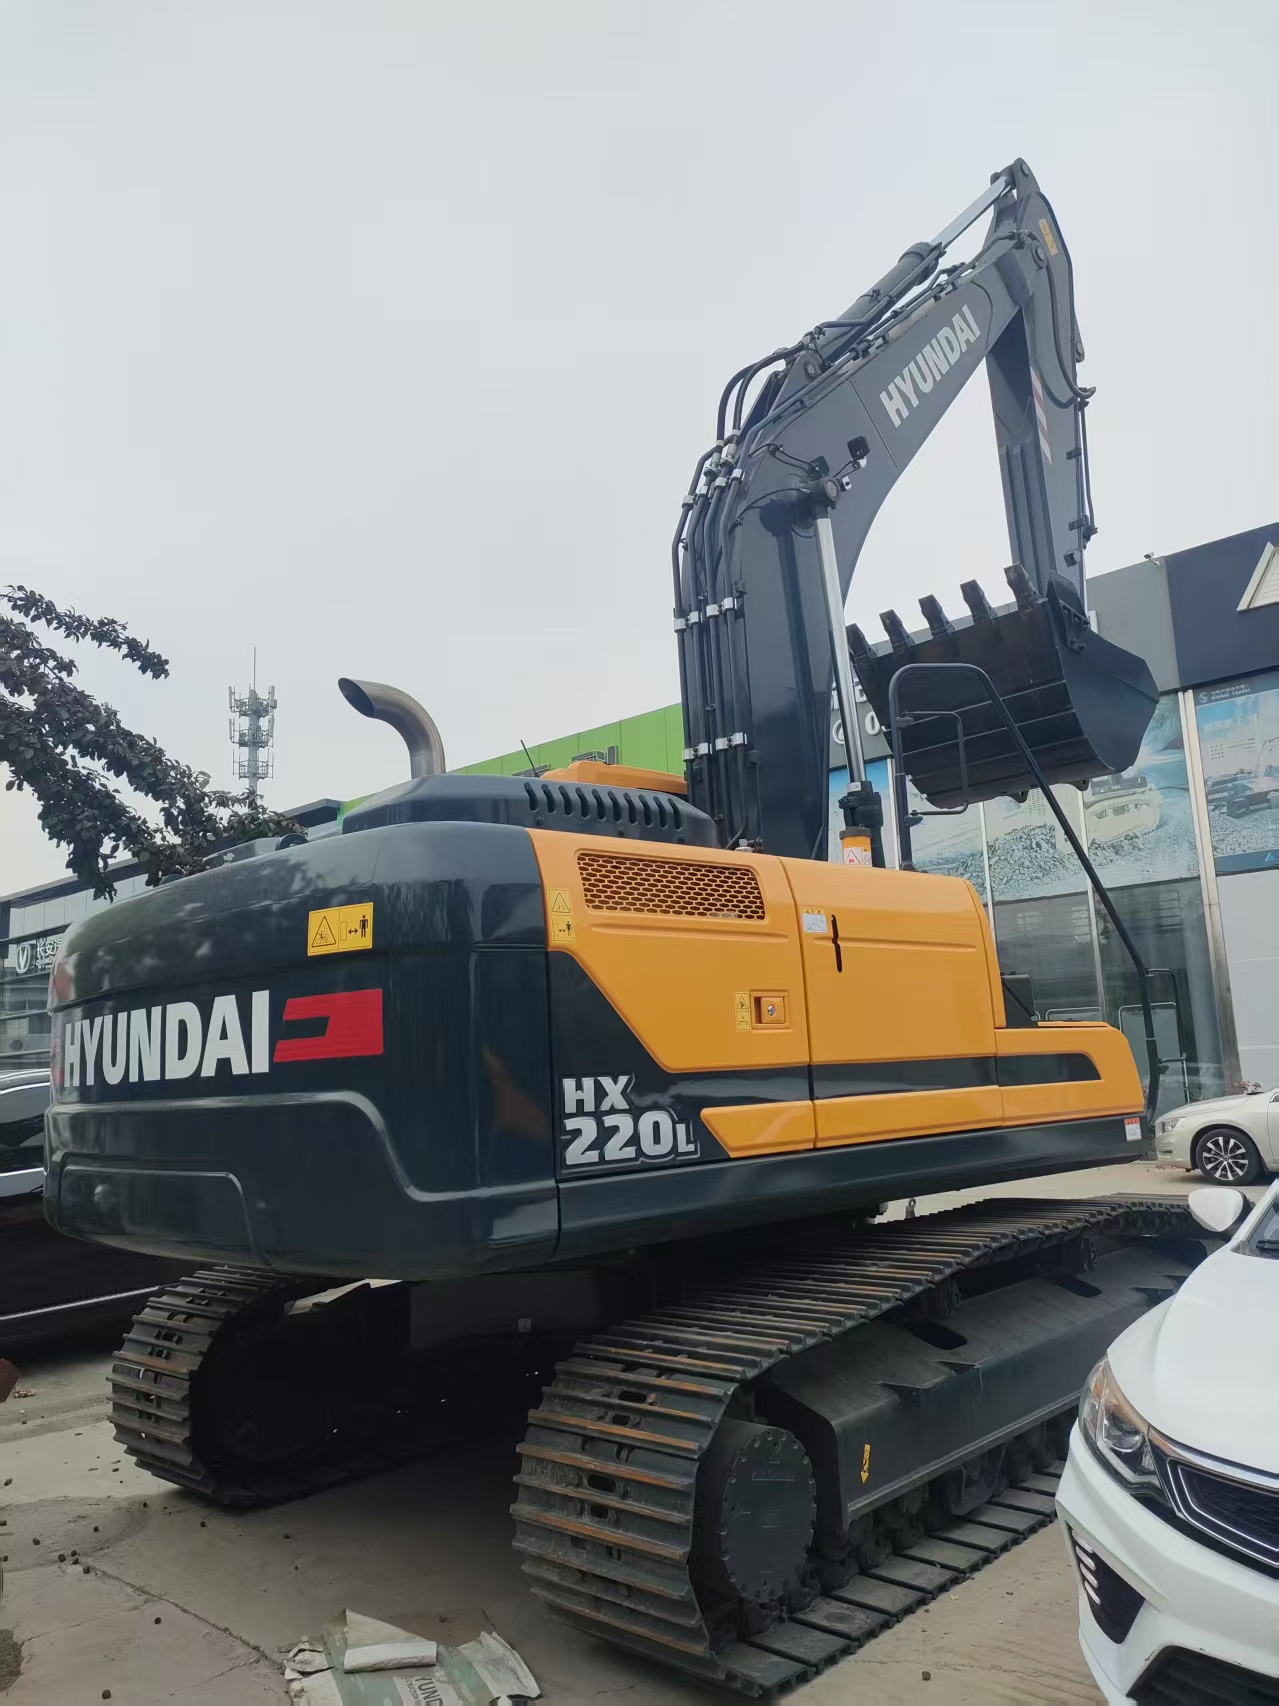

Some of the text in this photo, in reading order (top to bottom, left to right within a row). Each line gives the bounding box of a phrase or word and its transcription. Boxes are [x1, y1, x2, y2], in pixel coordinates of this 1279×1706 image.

[880, 304, 980, 428] HYUNDAI
[64, 990, 269, 1087] HYUNDAI
[562, 1075, 630, 1114] HX
[563, 1110, 695, 1165] 220L
